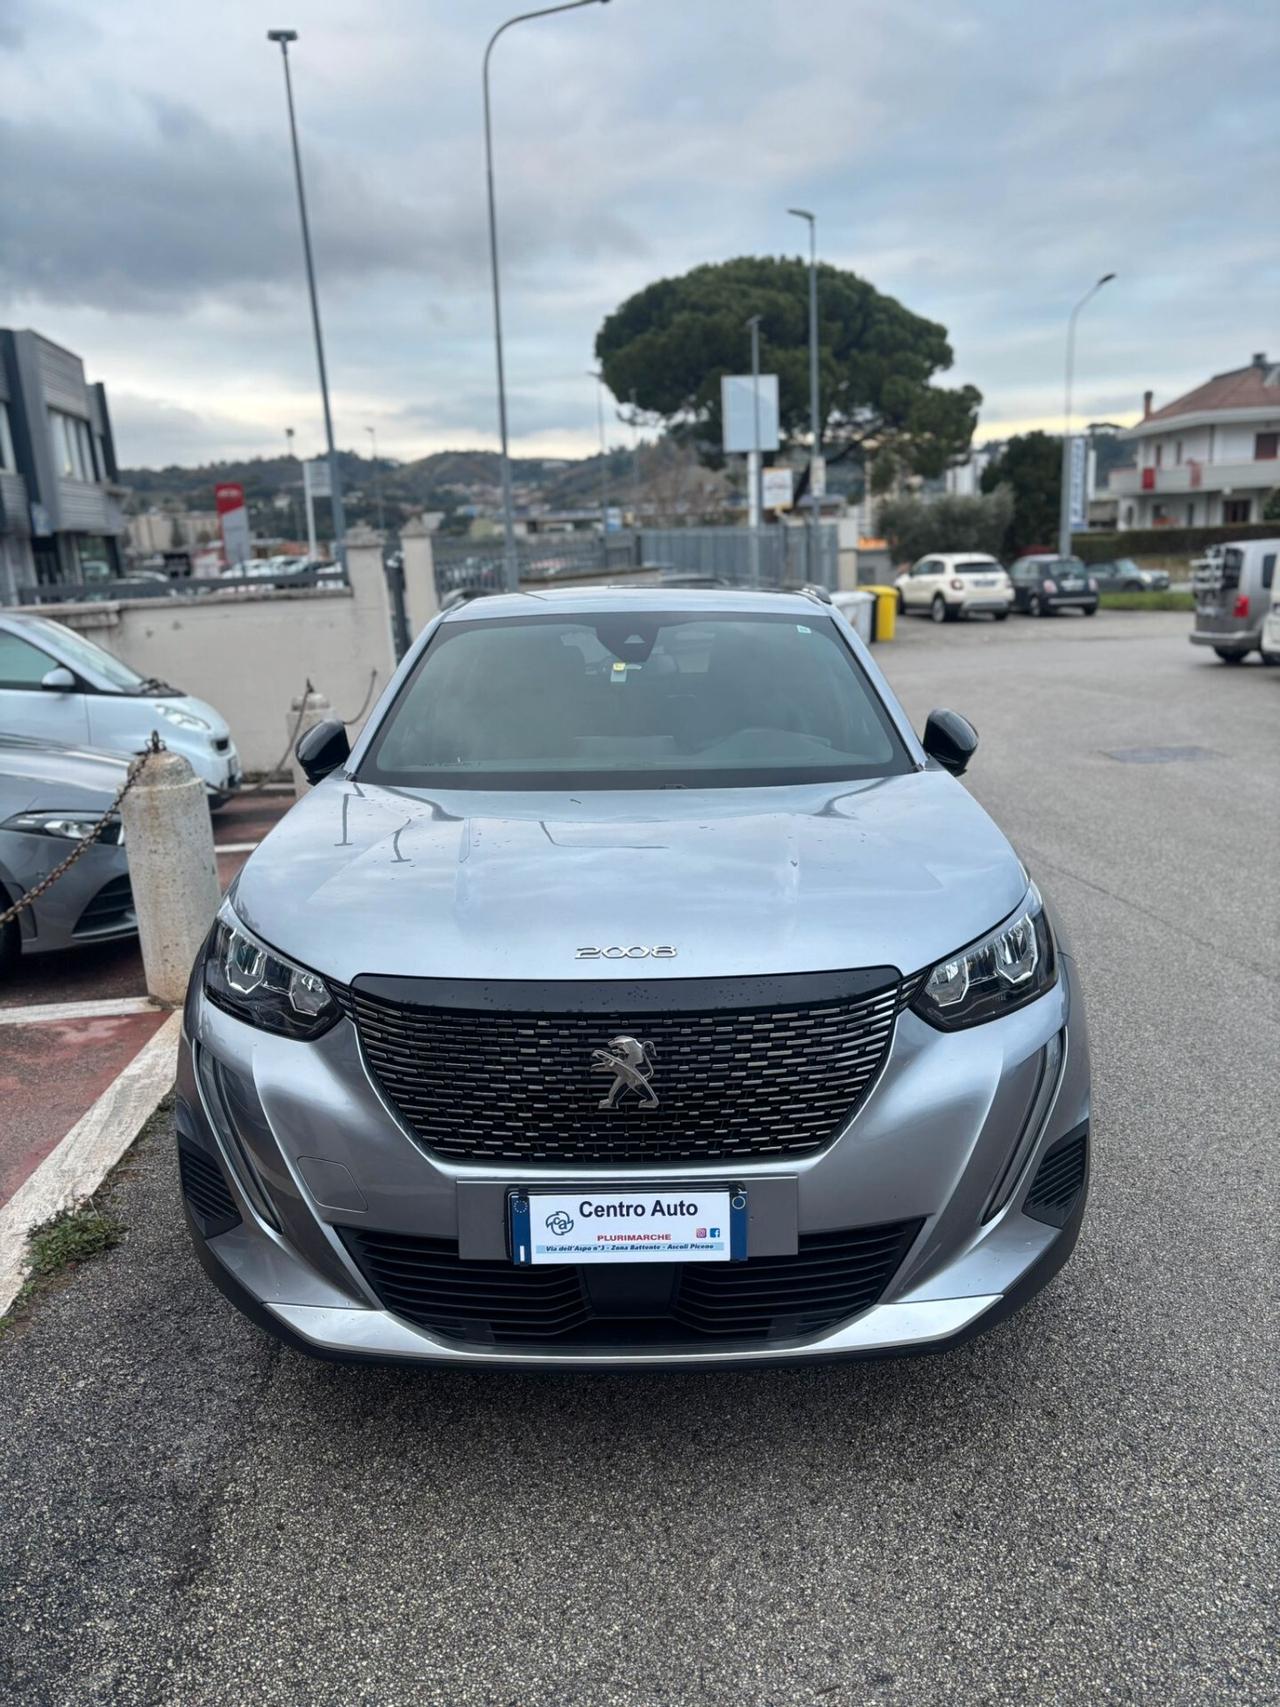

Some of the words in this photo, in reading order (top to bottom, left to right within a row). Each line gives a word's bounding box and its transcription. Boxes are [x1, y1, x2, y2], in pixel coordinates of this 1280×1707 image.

[575, 945, 678, 960] 2008
[579, 1201, 646, 1218] Centro
[651, 1200, 698, 1217] Auto
[597, 1234, 672, 1242] PLURIMARCHE
